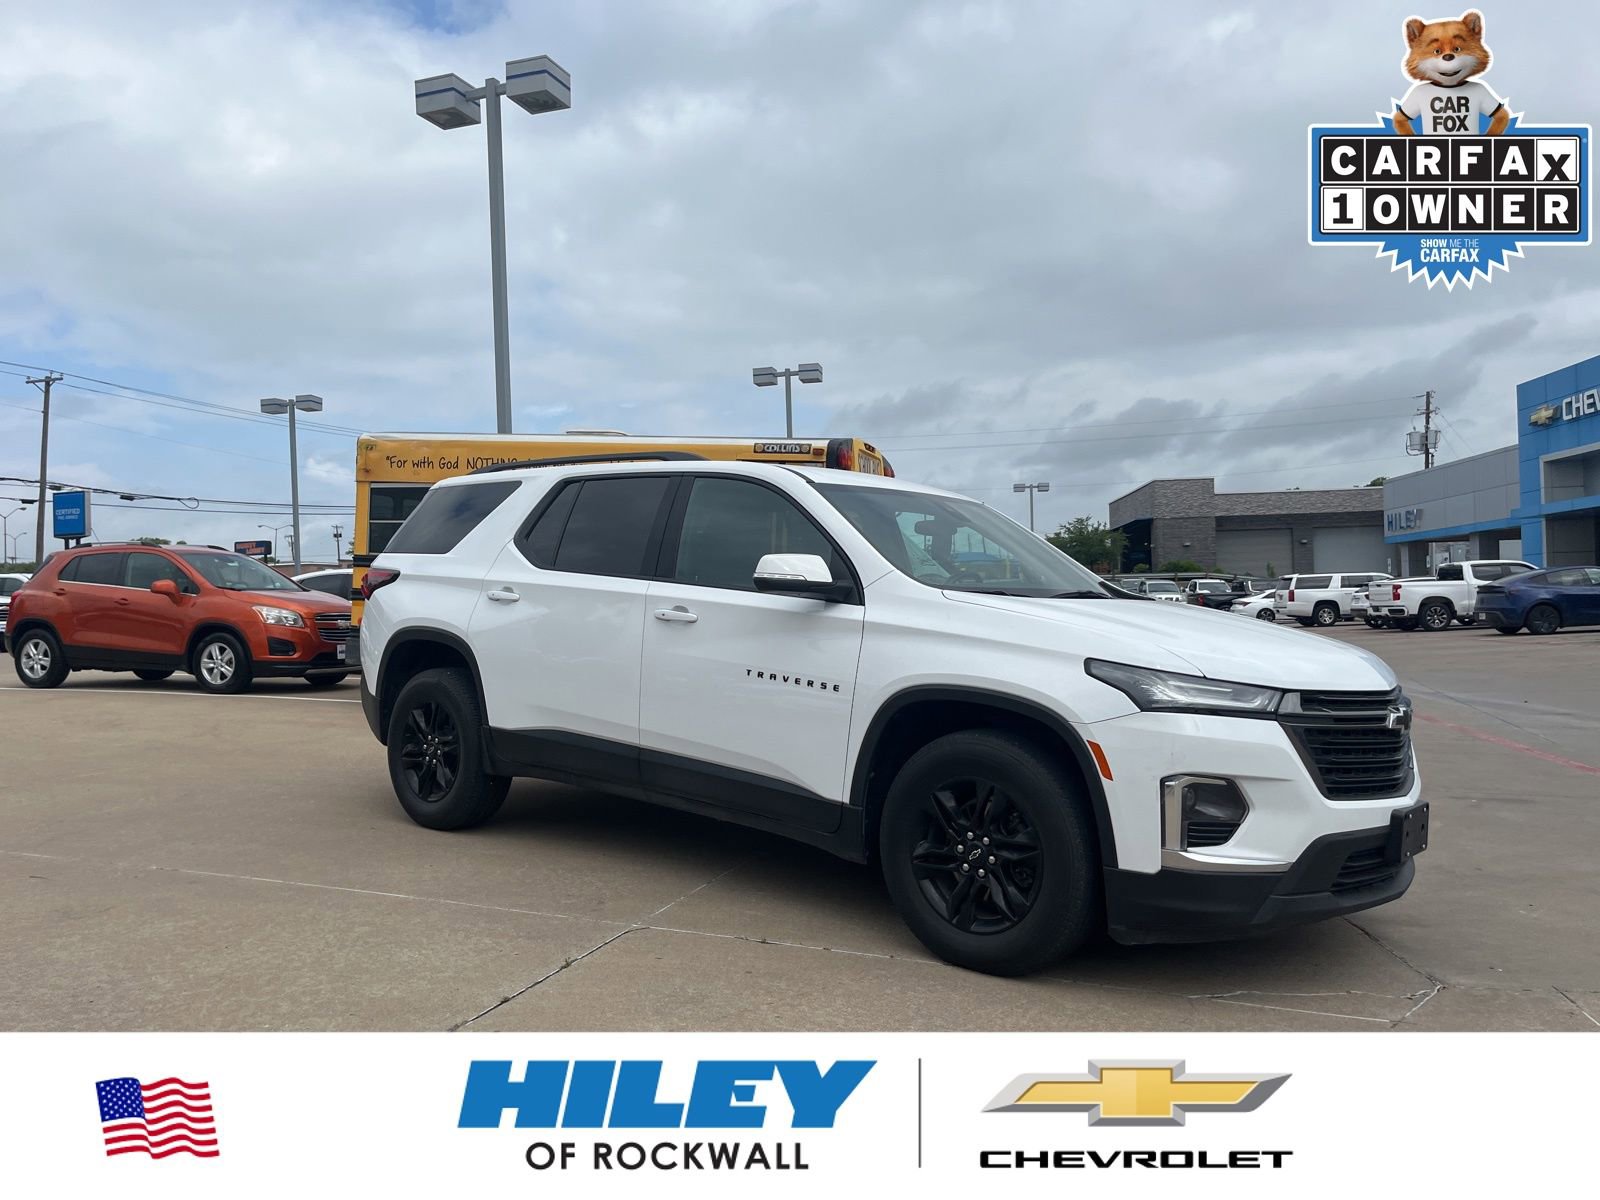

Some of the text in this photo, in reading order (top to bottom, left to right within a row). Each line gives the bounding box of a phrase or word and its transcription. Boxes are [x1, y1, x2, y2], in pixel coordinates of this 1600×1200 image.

[412, 455, 434, 470] with
[438, 456, 459, 470] God
[1387, 508, 1424, 531] HILEY
[745, 668, 840, 693] TRAVERSE
